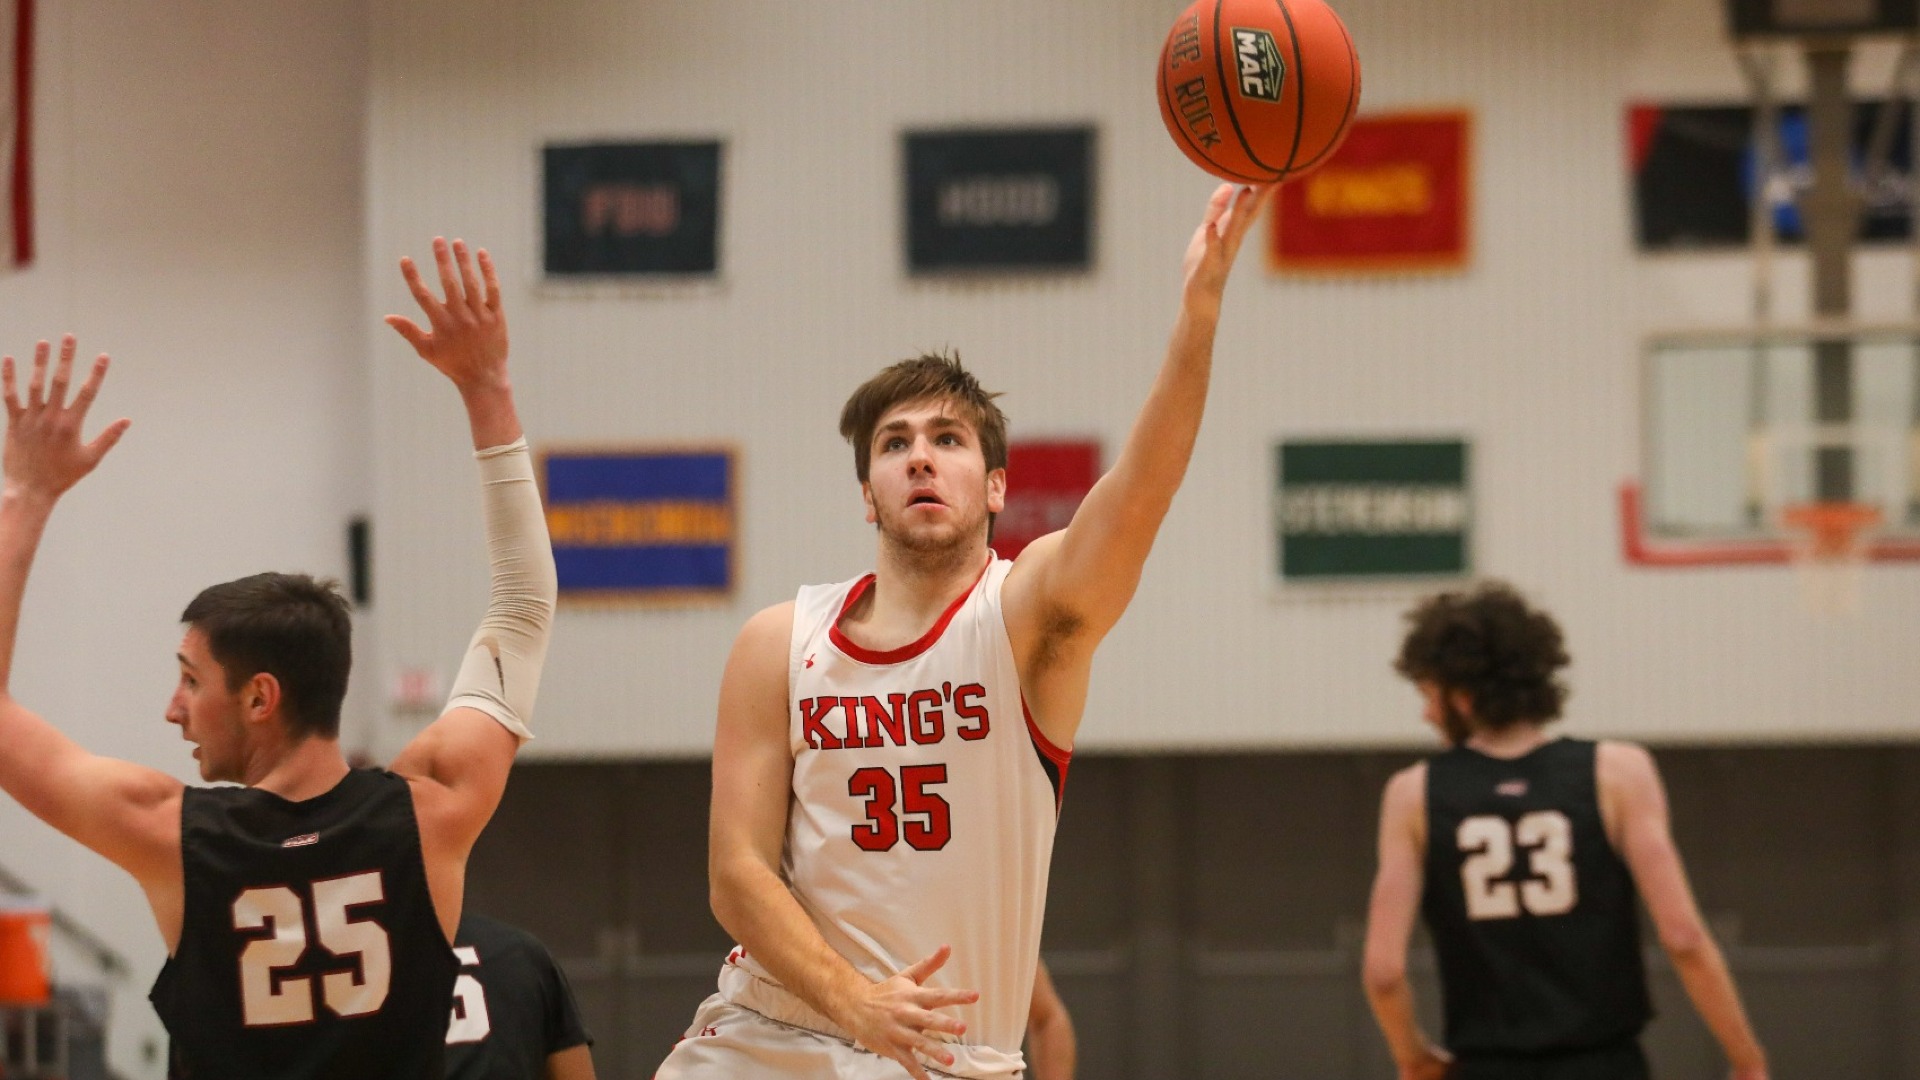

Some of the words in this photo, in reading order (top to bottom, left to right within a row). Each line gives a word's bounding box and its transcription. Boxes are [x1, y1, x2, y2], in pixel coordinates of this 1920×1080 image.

[1172, 12, 1200, 69] THE
[1236, 31, 1265, 96] MAC
[1175, 75, 1221, 149] ROCK
[800, 681, 990, 749] KING'S
[848, 763, 951, 852] 35
[1456, 811, 1578, 921] 23
[231, 869, 391, 1027] 25
